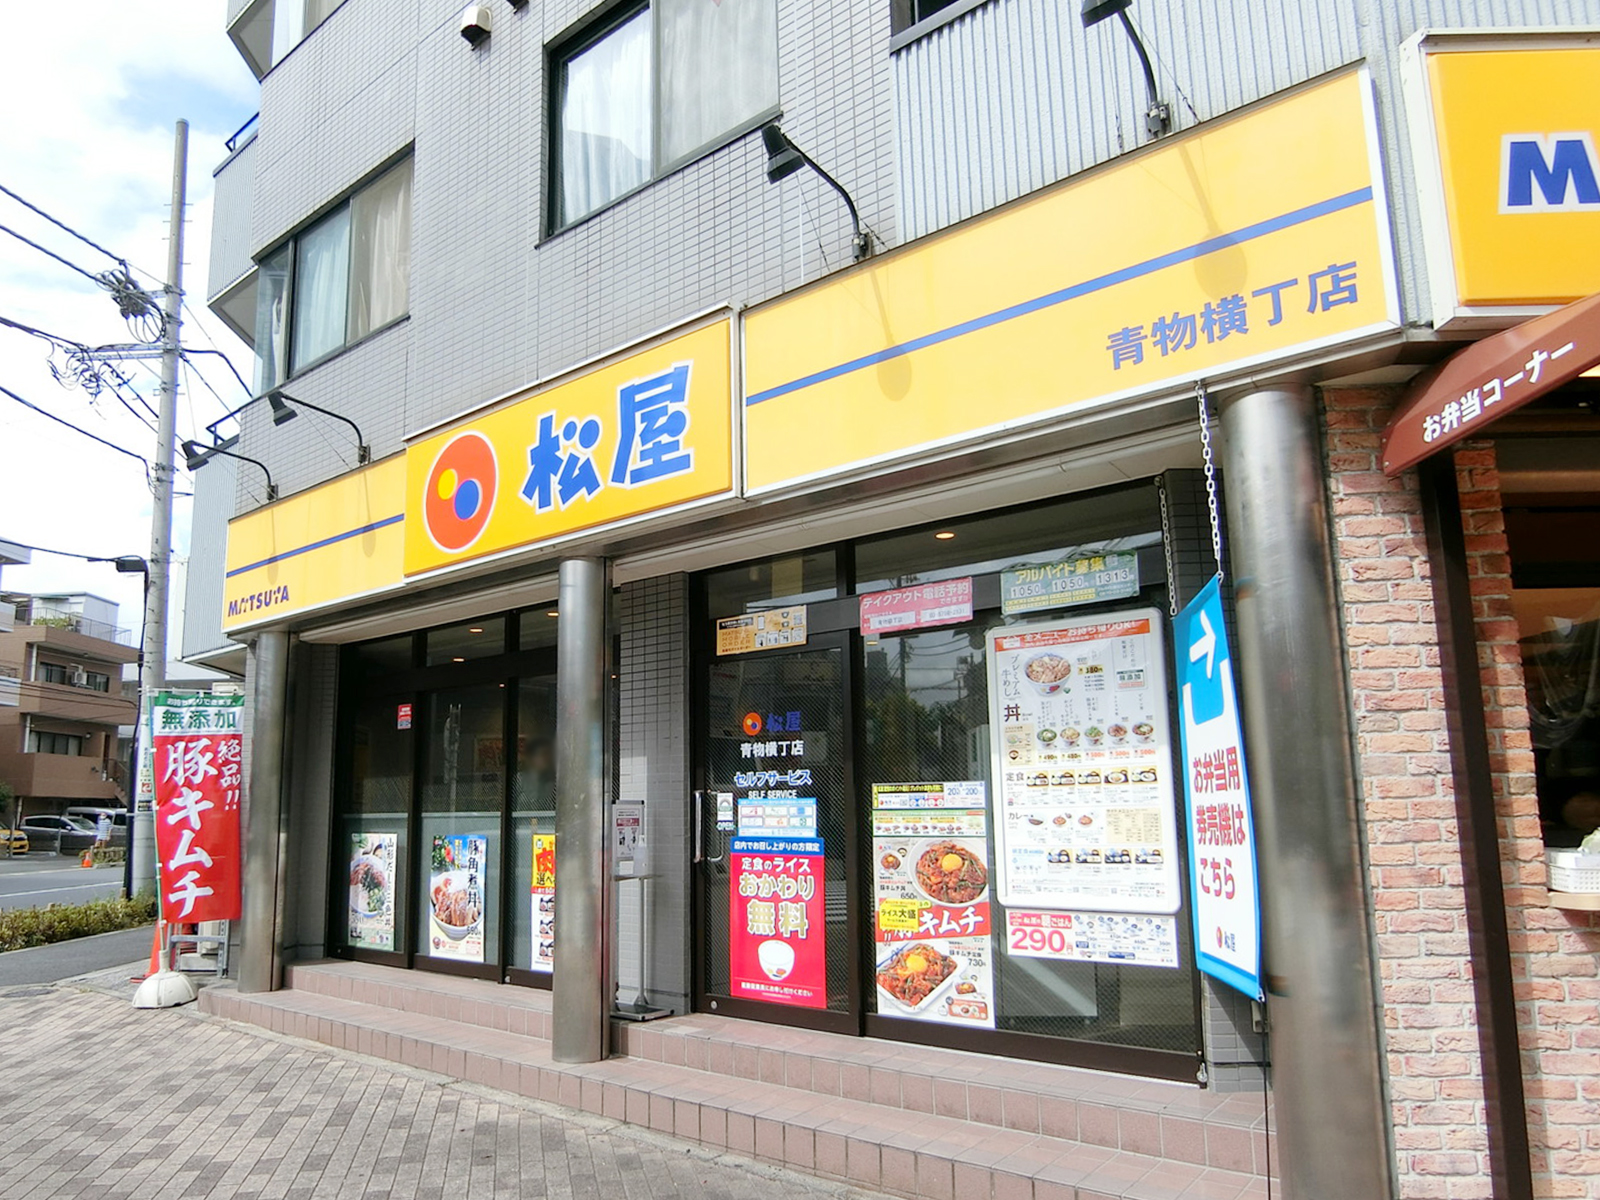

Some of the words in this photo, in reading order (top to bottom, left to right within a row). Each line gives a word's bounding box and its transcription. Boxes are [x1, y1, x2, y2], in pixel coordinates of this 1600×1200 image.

[1106, 261, 1358, 370] 青物横丁店
[1423, 342, 1574, 442] お弁当コーナー
[519, 362, 693, 512] 松屋
[1015, 556, 1105, 584] アルバイト募集
[228, 585, 289, 617] MATSUYA
[863, 582, 969, 609] テイクアウト電話予約
[162, 709, 236, 729] 無添加
[766, 711, 801, 732] 松屋
[1004, 703, 1021, 722] 丼
[740, 740, 804, 758] 青物横丁店
[217, 739, 241, 811] 絶品!!
[734, 769, 812, 787] セルフサービス
[1193, 746, 1241, 793] お弁当用
[748, 790, 766, 799] SELF
[767, 789, 797, 799] SERVICE
[163, 737, 219, 919] 豚キムチ
[1196, 803, 1246, 846] 券売機は
[733, 840, 820, 852] 店内でお召し上がりの方限定
[468, 839, 479, 908] 豚角煮丼
[742, 857, 811, 873] 定食のライス
[1201, 857, 1235, 900] こちら
[739, 872, 815, 900] おかわり
[747, 899, 809, 939] 無料
[881, 908, 917, 919] ライス大盛
[1011, 928, 1074, 956] 290円
